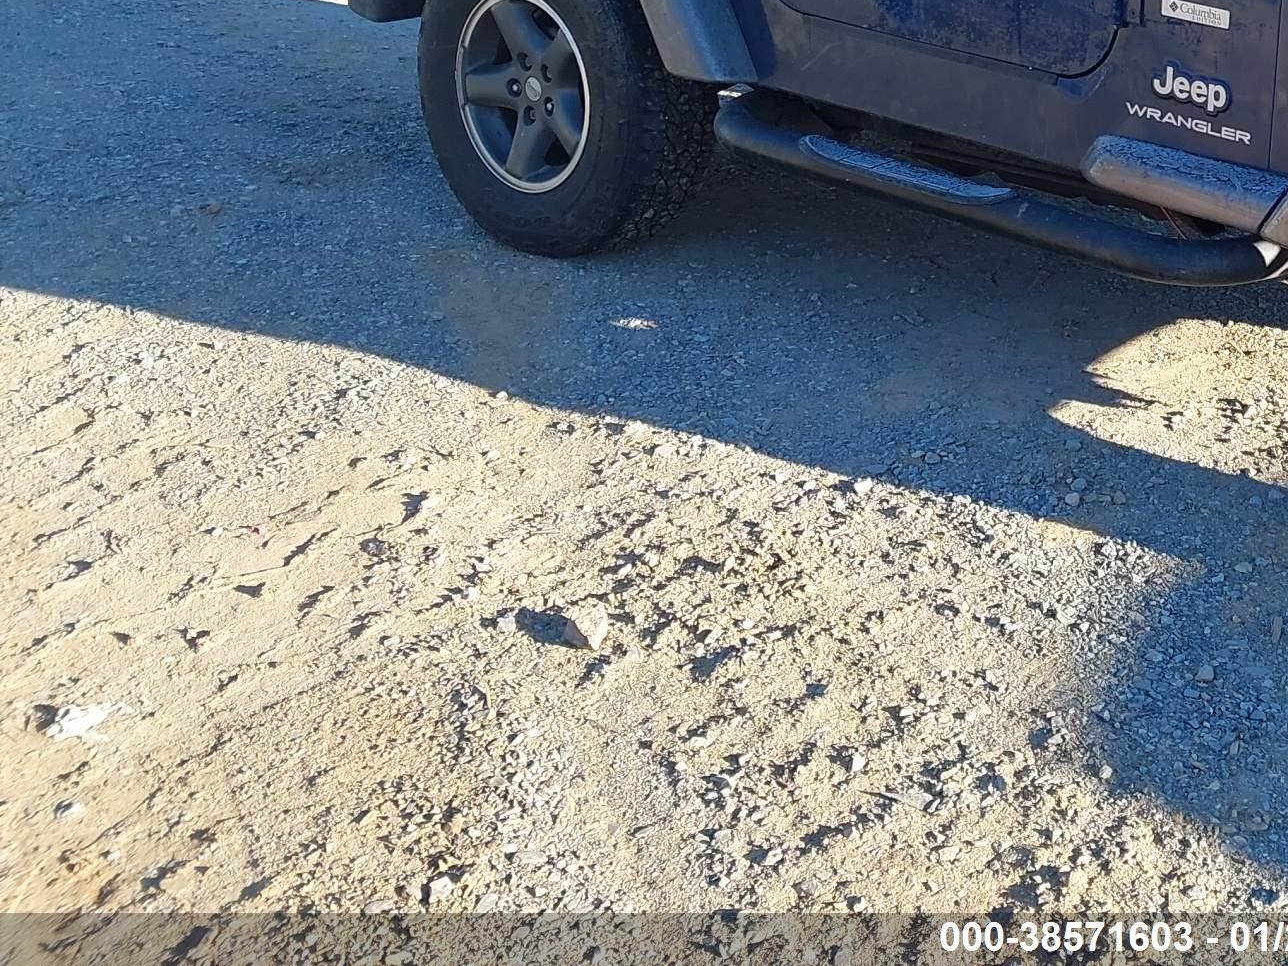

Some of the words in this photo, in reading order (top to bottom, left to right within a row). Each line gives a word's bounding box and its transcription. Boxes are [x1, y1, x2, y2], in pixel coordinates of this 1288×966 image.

[1180, 2, 1222, 21] Columbia
[1153, 65, 1227, 112] Jeep
[1126, 101, 1251, 145] WRANGLER
